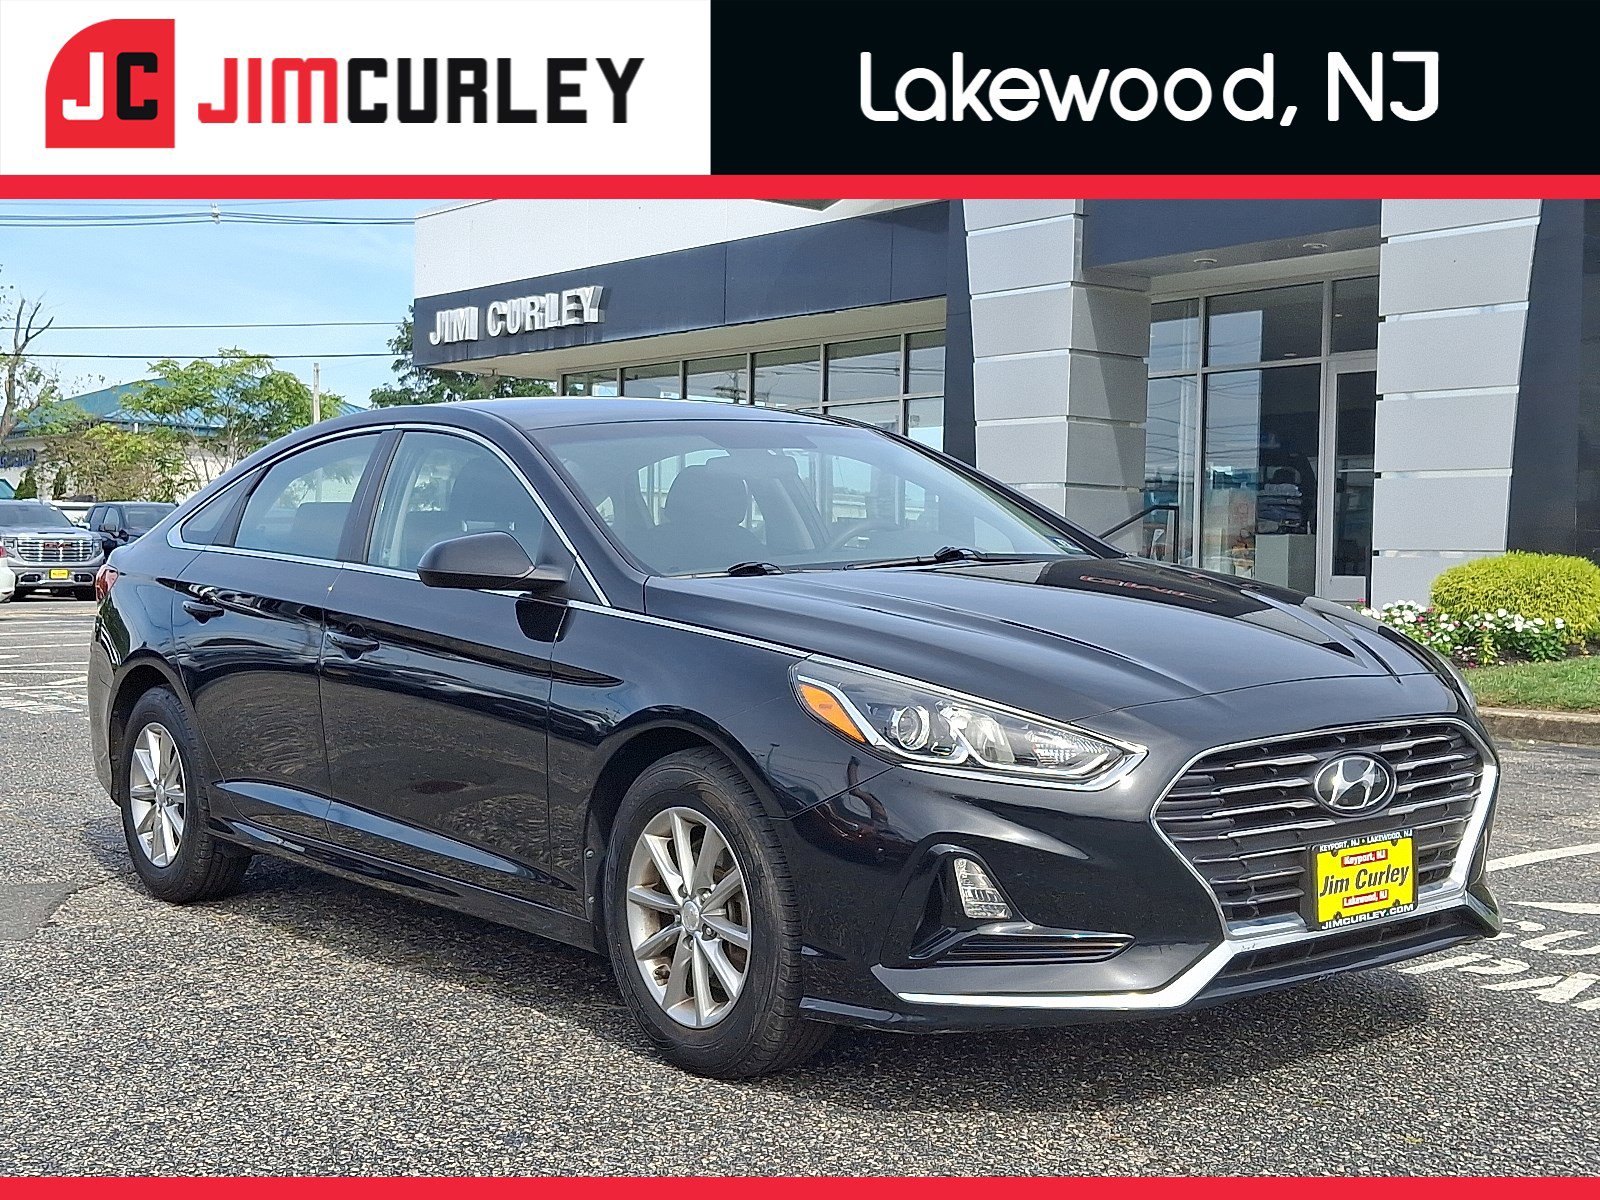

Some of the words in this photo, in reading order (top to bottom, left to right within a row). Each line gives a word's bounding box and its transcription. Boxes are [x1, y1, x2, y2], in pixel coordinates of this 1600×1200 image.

[429, 306, 479, 345] JIM
[487, 286, 604, 337] CURLEY
[1351, 838, 1360, 847] NJ
[1404, 829, 1413, 838] NJ
[1376, 849, 1386, 859] NJ
[1319, 875, 1350, 897] Jim
[1355, 864, 1409, 890] Curley
[1321, 903, 1414, 930] JIMCURLEY.COM
